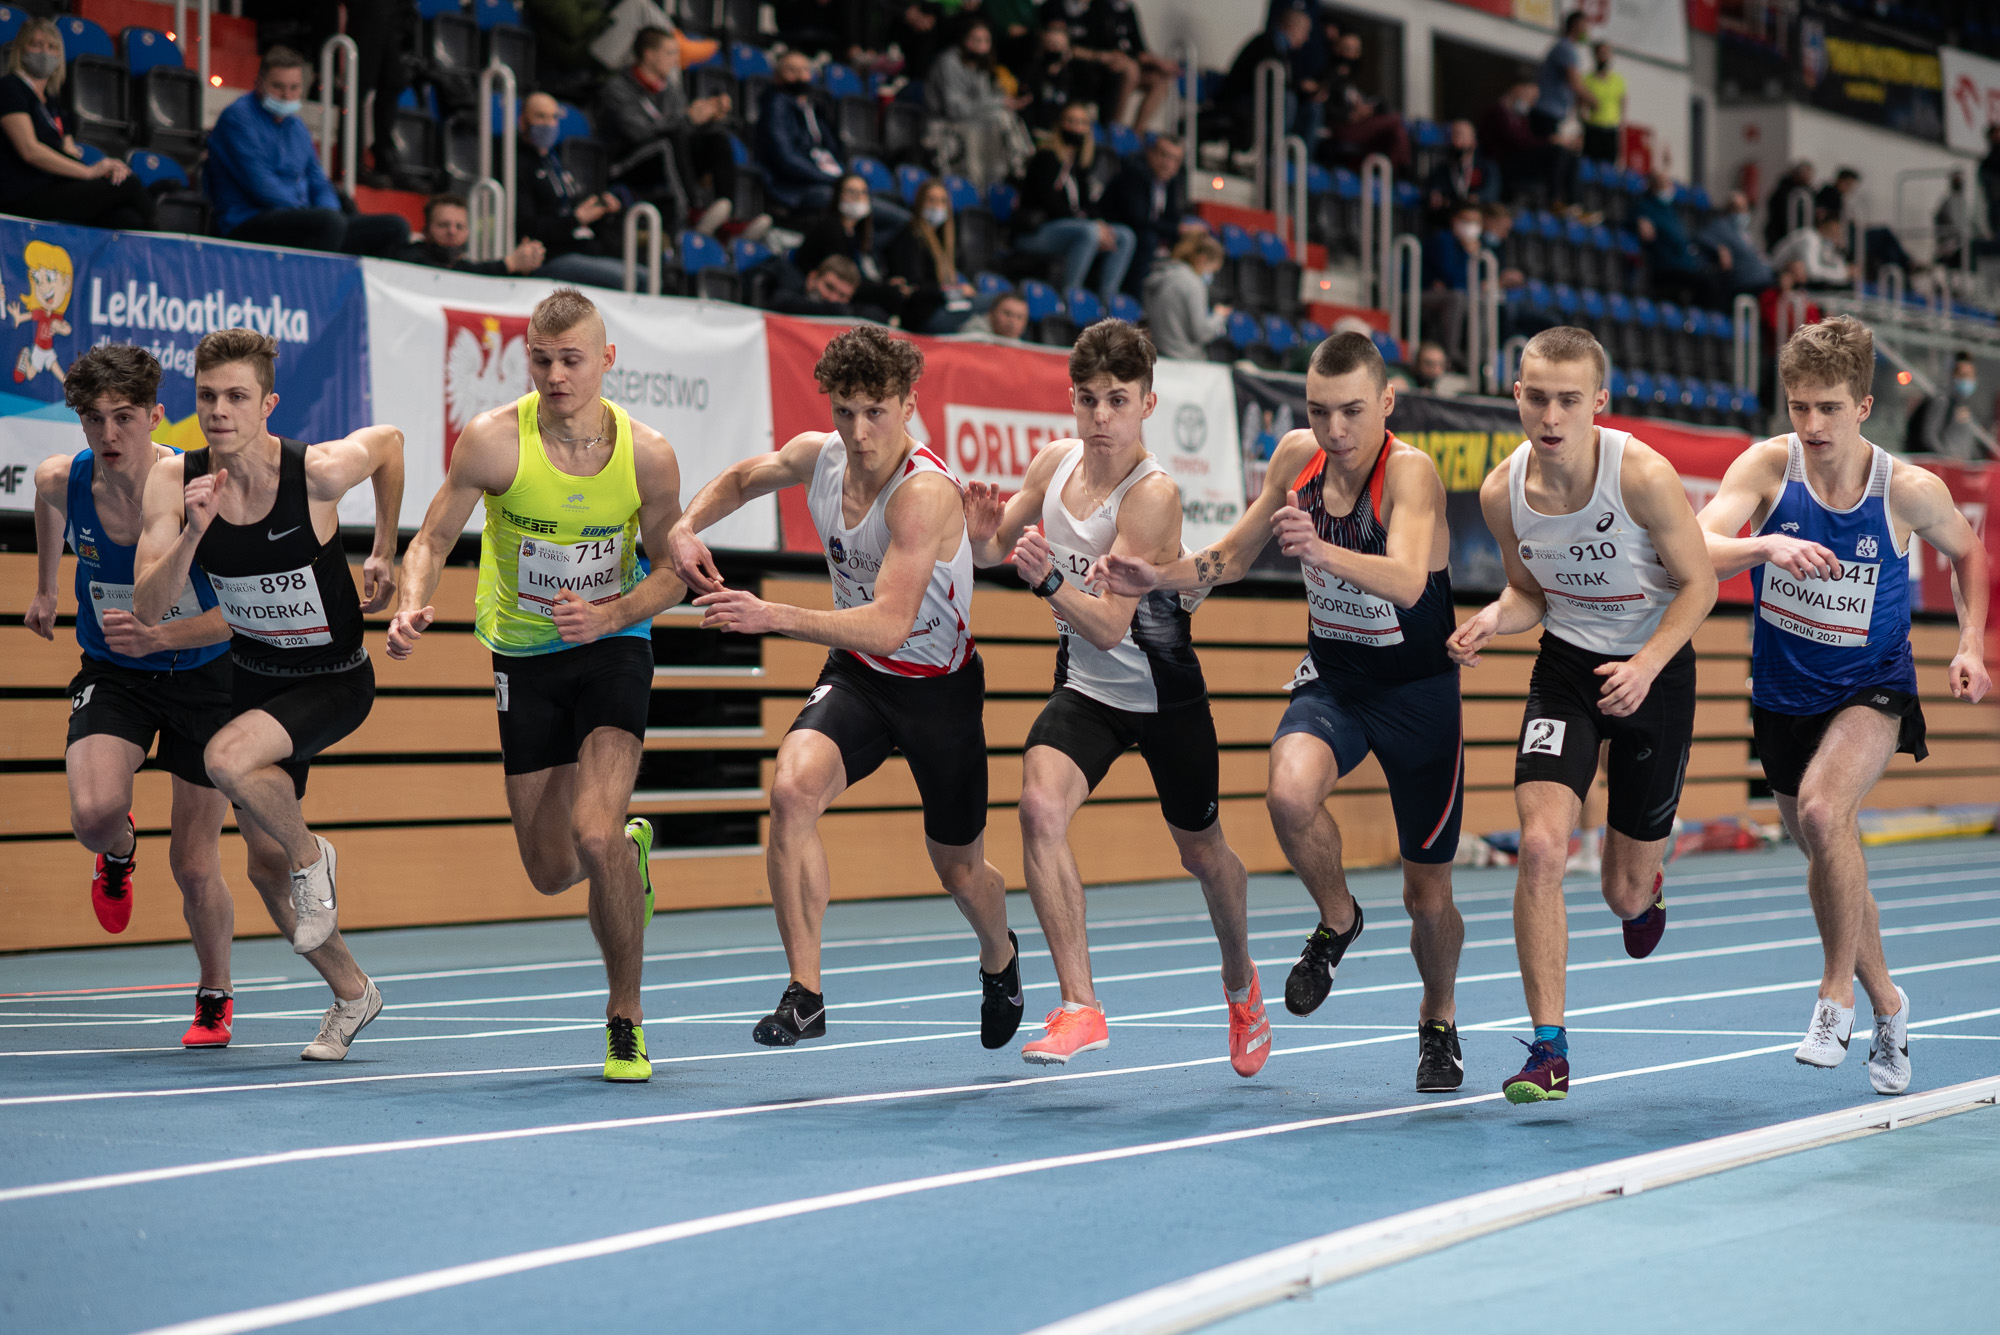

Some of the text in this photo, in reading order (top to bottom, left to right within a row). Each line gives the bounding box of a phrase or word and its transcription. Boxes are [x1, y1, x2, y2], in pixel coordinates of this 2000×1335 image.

[90, 276, 310, 344] Lekkoatletyka
[148, 337, 196, 379] żdeg
[602, 367, 710, 411] sterstwo
[957, 420, 1073, 477] ORLE
[575, 538, 616, 564] 714
[1535, 541, 1617, 562] TORUŃ 910
[1069, 554, 1094, 577] 12
[1829, 563, 1876, 586] 041
[259, 572, 307, 594] 898
[529, 568, 614, 591] LIKWIARZ
[1555, 571, 1610, 586] CITAK
[1307, 588, 1391, 619] OGORZELSKI
[1566, 598, 1626, 612] TORUŃ 2021
[1770, 576, 1867, 614] KOWALSKI
[225, 601, 317, 619] WYDERKA
[1055, 621, 1079, 635] ORU
[1319, 628, 1380, 645] TORUŃ 2021
[1779, 617, 1842, 644] TORUŃ 2021
[285, 638, 309, 646] 2021
[1530, 721, 1555, 750] 2
